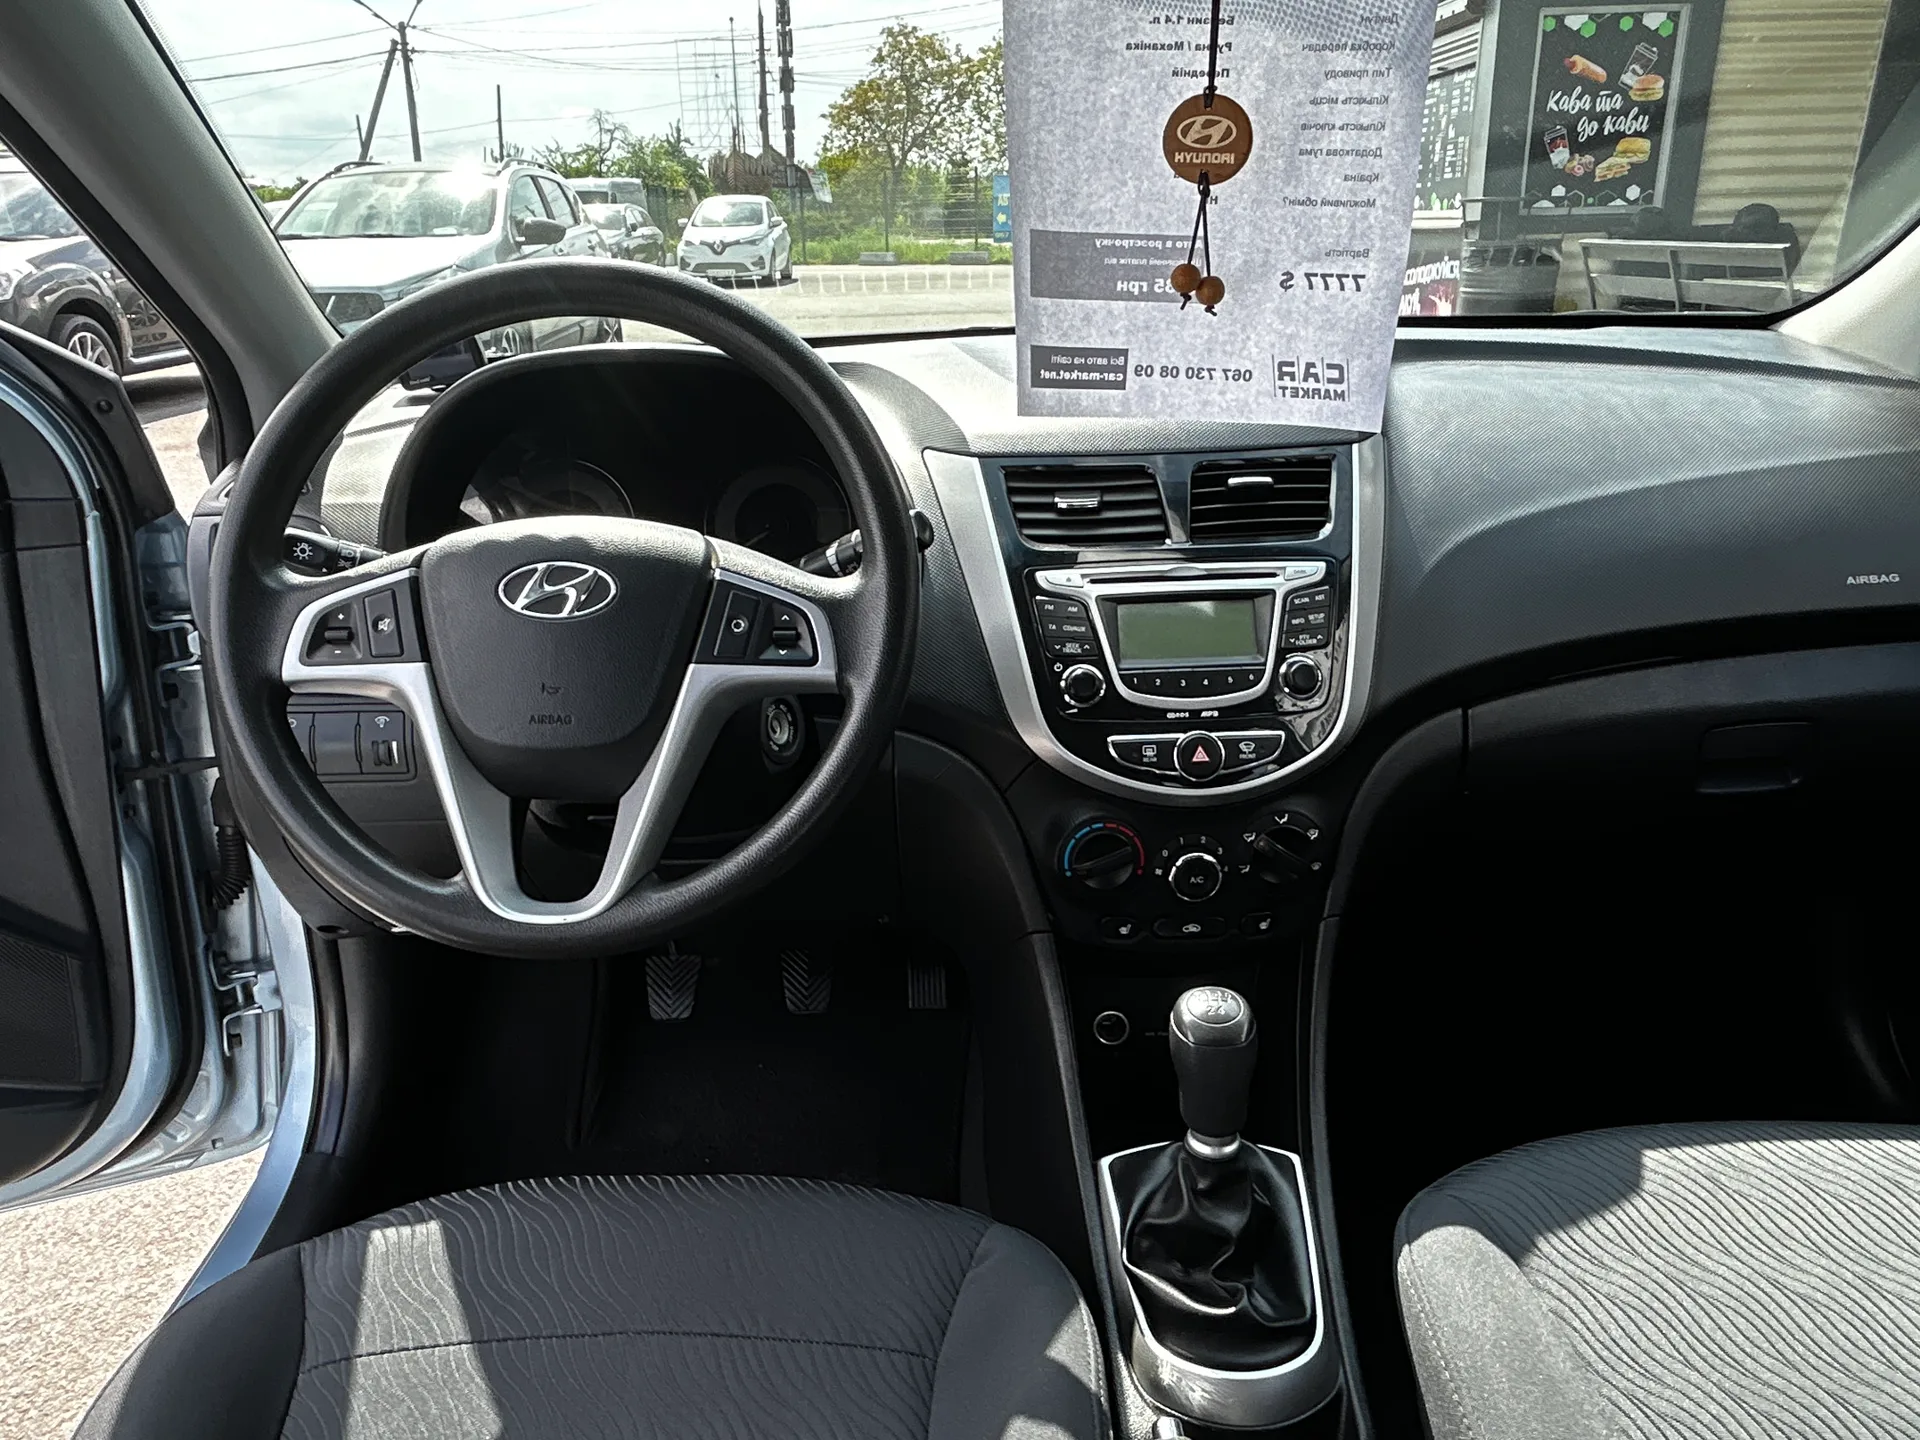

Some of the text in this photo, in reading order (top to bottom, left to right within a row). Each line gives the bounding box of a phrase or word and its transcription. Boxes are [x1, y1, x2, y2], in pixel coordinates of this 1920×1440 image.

[1546, 86, 1593, 114] Кава
[1602, 107, 1650, 135] кави
[1175, 152, 1235, 165] HYUNDAI
[1846, 573, 1900, 585] AIRBAG
[1133, 677, 1138, 685] 1
[1155, 678, 1161, 686] 2
[1202, 678, 1208, 686] 4
[1227, 676, 1234, 684] 5
[1180, 836, 1184, 845] 1
[1200, 836, 1206, 844] 2
[1162, 849, 1168, 858] 0
[1217, 847, 1223, 855] 3
